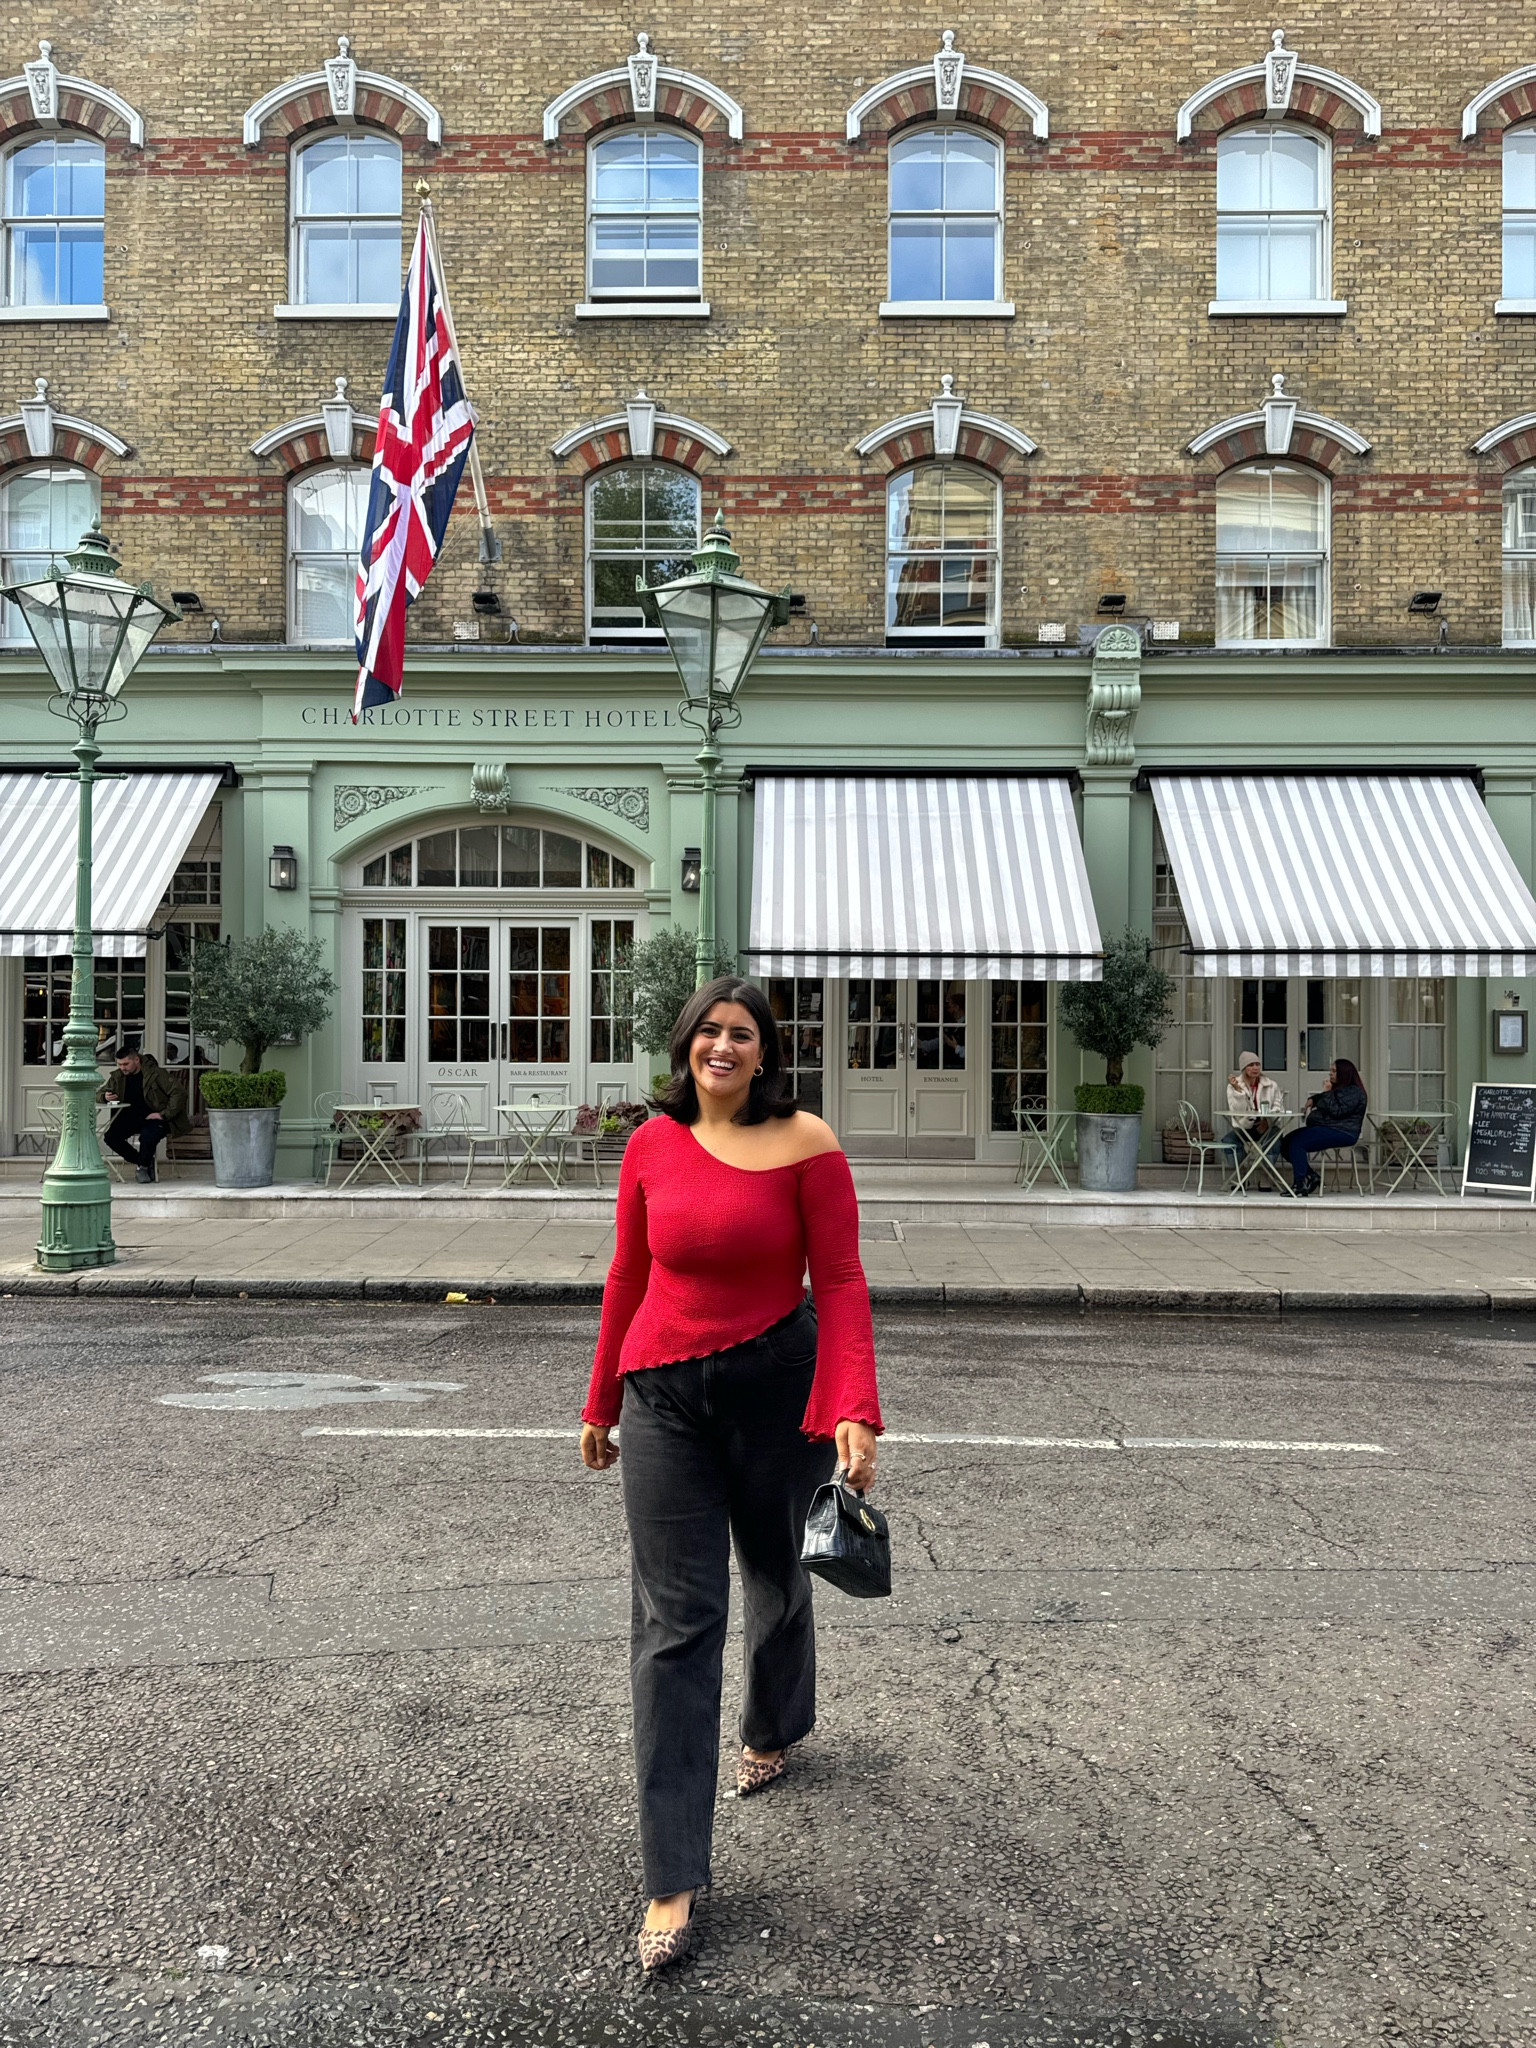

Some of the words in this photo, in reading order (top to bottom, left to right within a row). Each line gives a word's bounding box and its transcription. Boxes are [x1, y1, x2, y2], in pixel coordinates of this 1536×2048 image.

[302, 707, 462, 726] CHARLOTTE
[472, 709, 575, 727] STREET
[585, 710, 677, 728] HOTEL
[438, 1067, 478, 1077] OSCAR
[1508, 1102, 1523, 1111] Club
